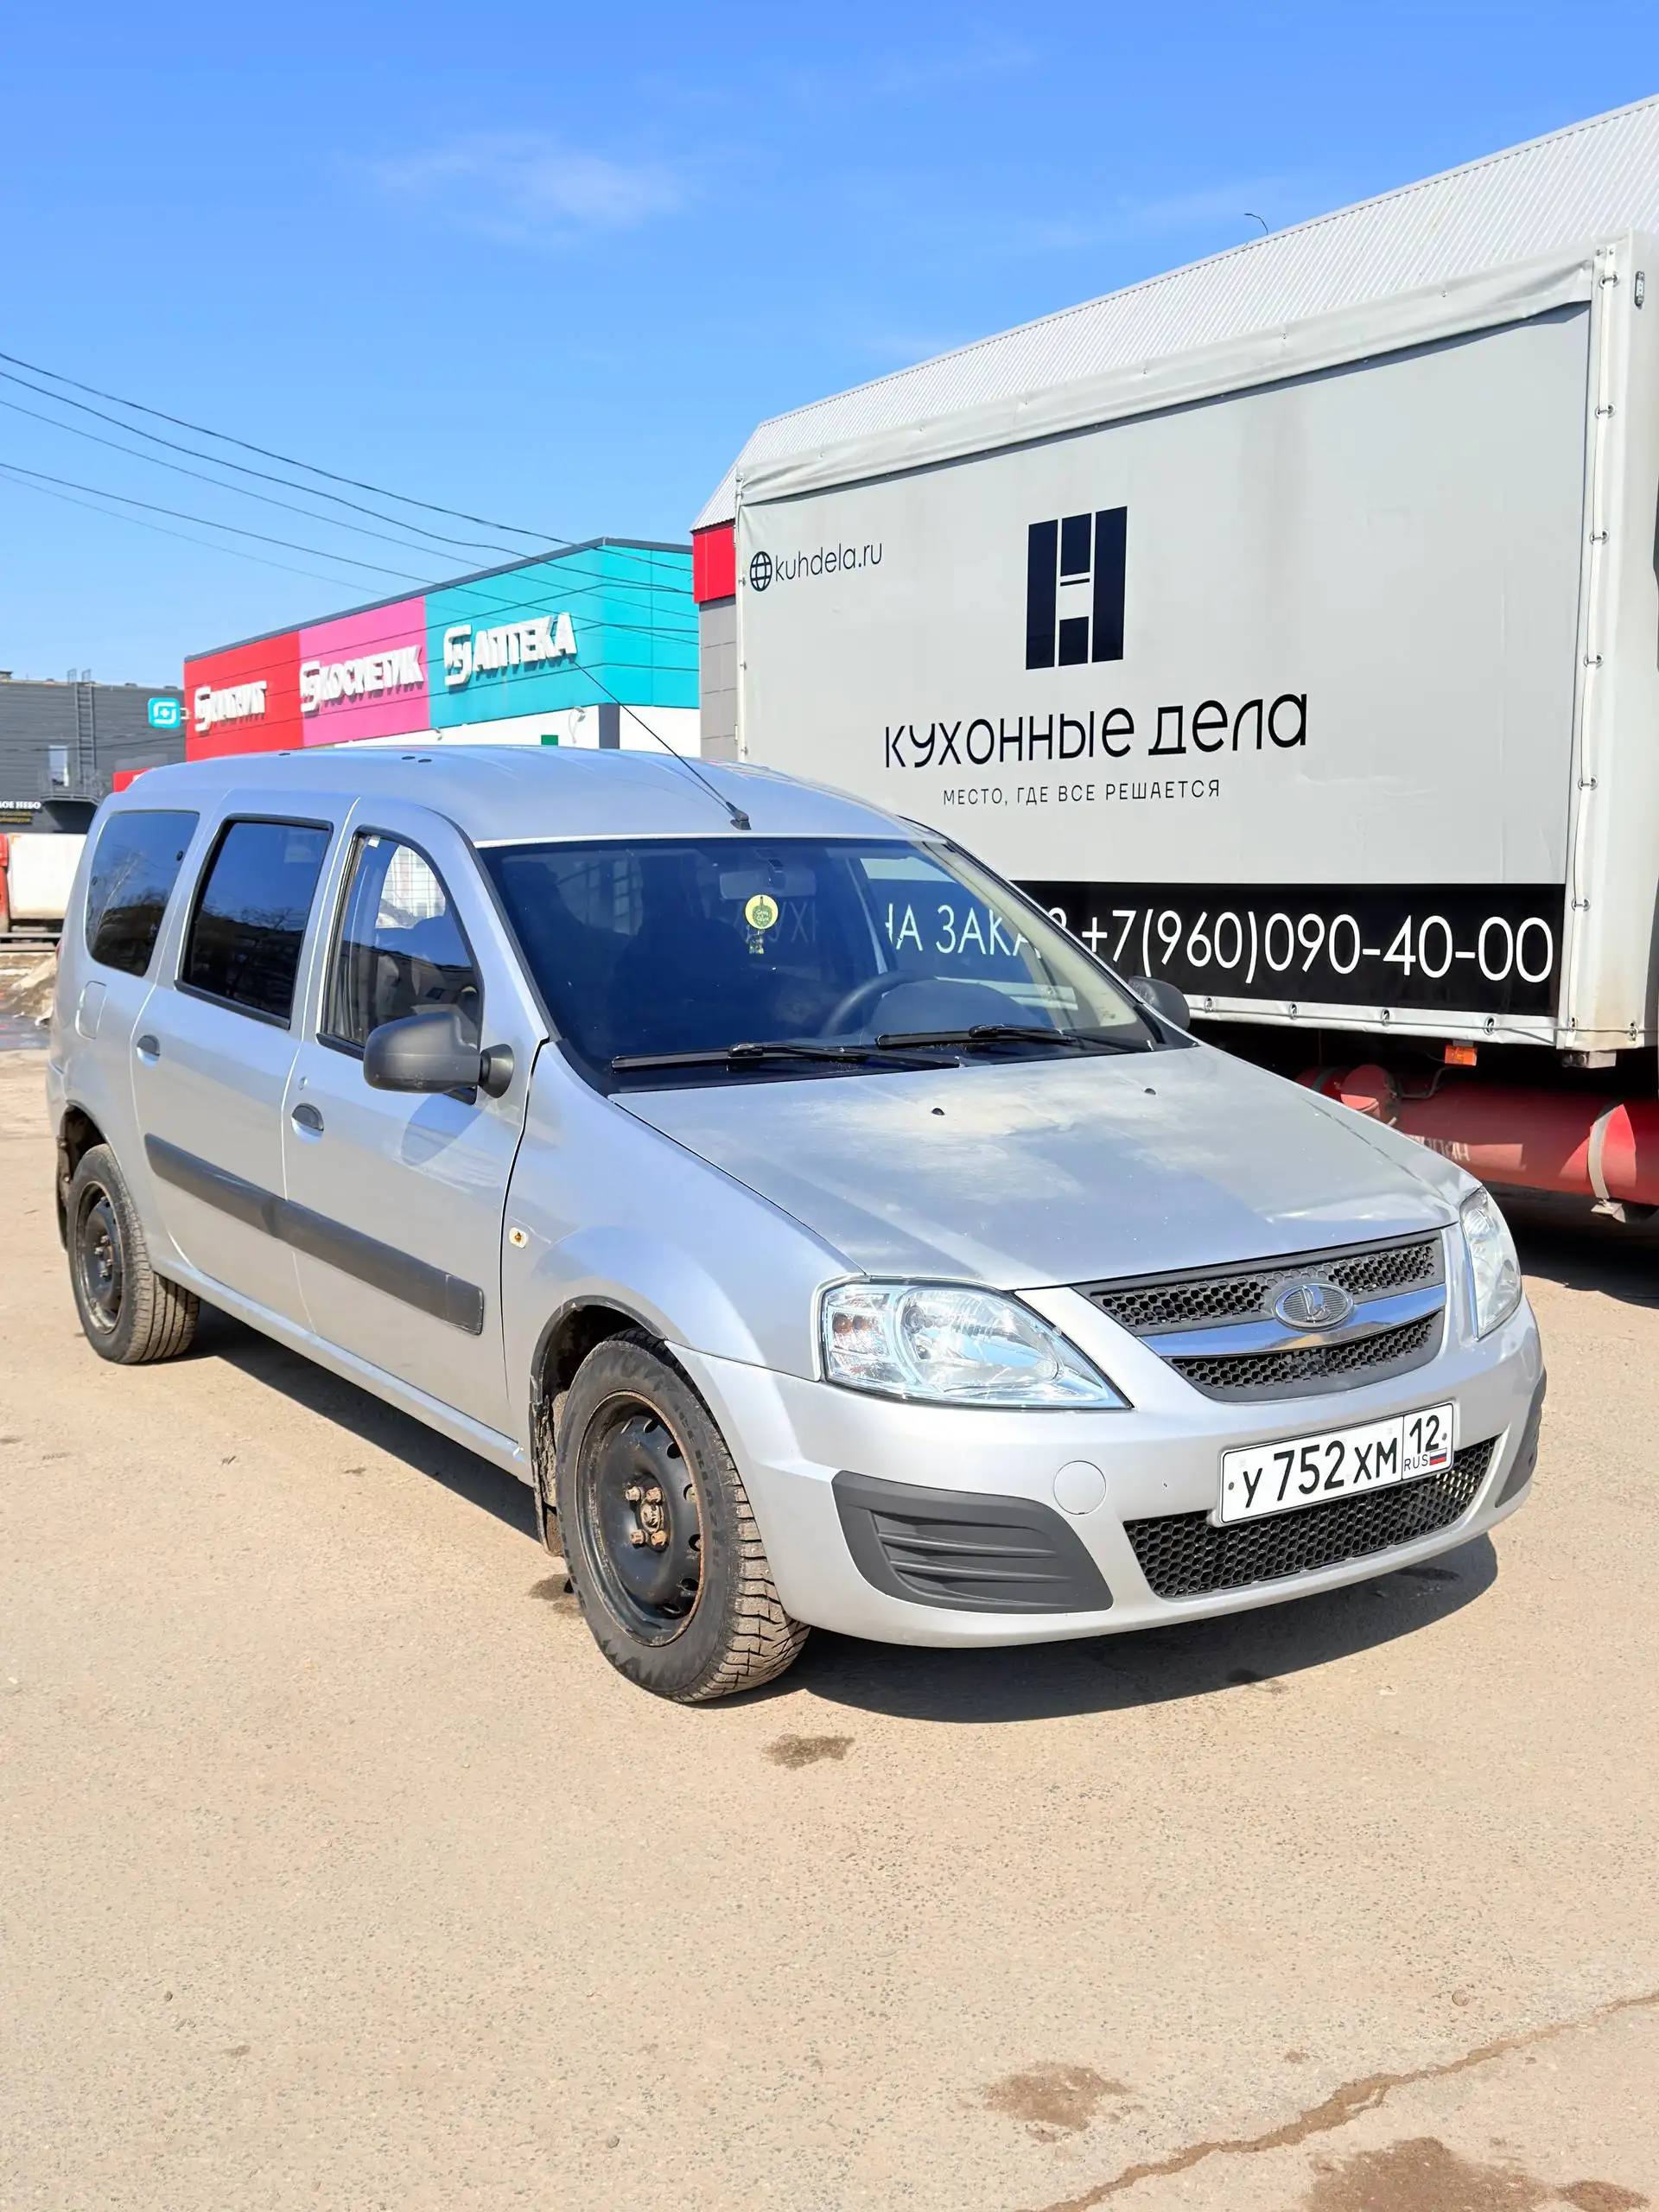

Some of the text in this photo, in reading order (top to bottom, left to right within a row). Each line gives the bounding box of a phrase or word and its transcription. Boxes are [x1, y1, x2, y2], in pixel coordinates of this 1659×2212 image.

[774, 542, 883, 582] kuhdela.ru
[473, 611, 578, 671] АПТЕКА
[942, 779, 1221, 806] МЕСТО, ГДЕ ВСЕ РЕШАЕТСЯ
[1082, 908, 1554, 984] +7(960)090-40-00
[1409, 1414, 1440, 1454] 12
[1403, 1454, 1429, 1472] RUS
